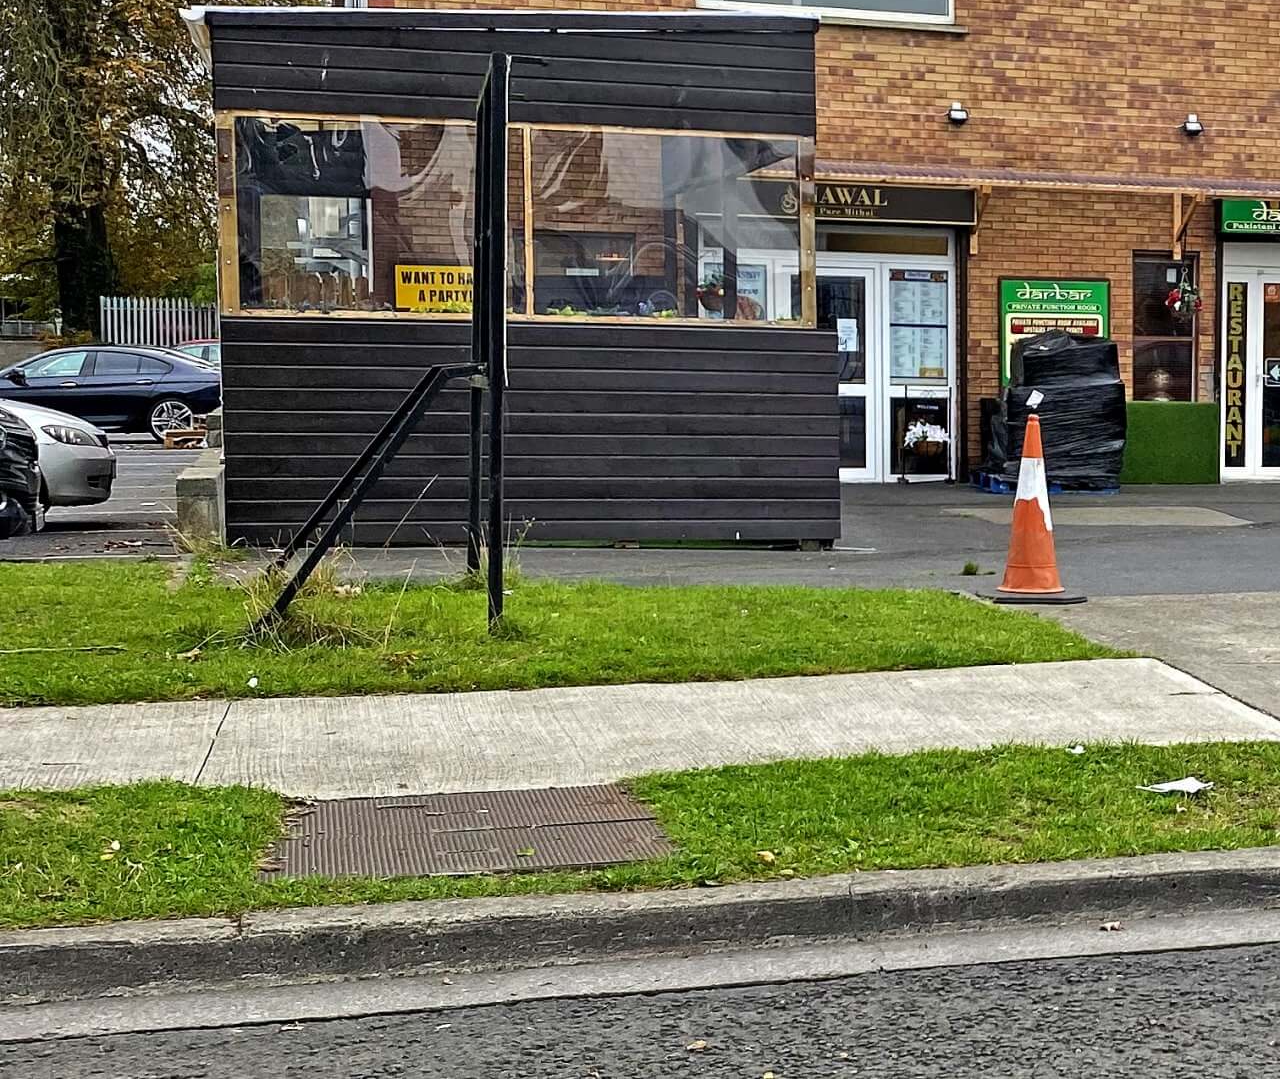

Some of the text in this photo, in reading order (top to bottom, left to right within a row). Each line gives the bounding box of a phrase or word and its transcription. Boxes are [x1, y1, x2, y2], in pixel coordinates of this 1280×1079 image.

[814, 186, 888, 206] AWAL
[401, 271, 473, 285] WANT TO HA
[418, 290, 426, 301] A
[1016, 282, 1092, 300] darbar
[1225, 284, 1244, 457] RESTAURANT
